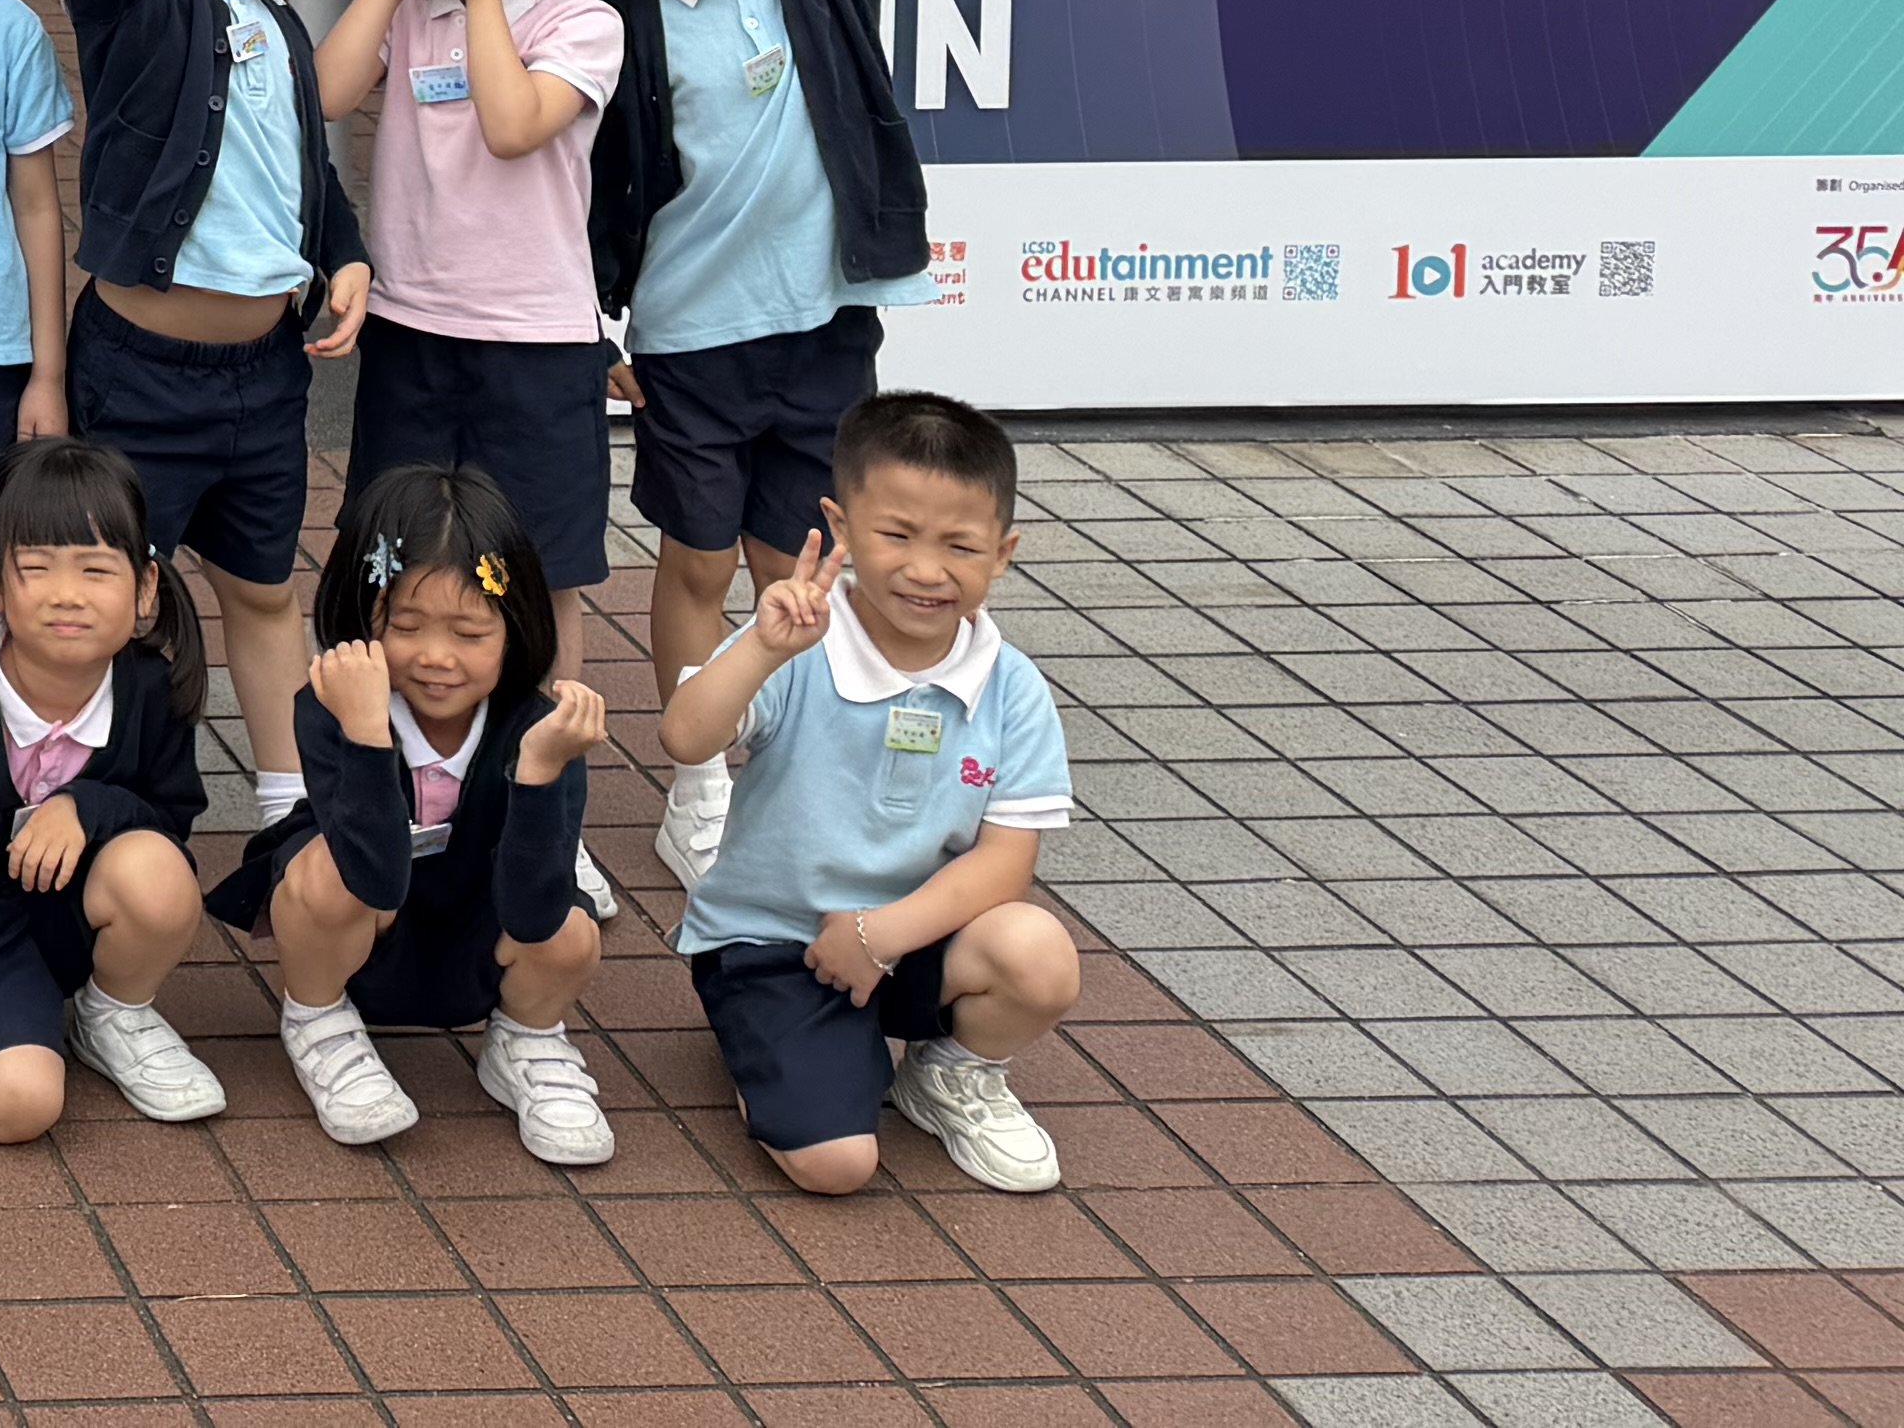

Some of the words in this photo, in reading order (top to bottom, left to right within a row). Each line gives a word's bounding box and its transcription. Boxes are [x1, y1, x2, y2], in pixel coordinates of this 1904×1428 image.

[1021, 241, 1056, 254] LCSD
[1021, 240, 1274, 282] edutainment
[1481, 247, 1587, 276] academy
[1022, 287, 1116, 303] CHANNEL
[1479, 274, 1571, 296] 入門教室
